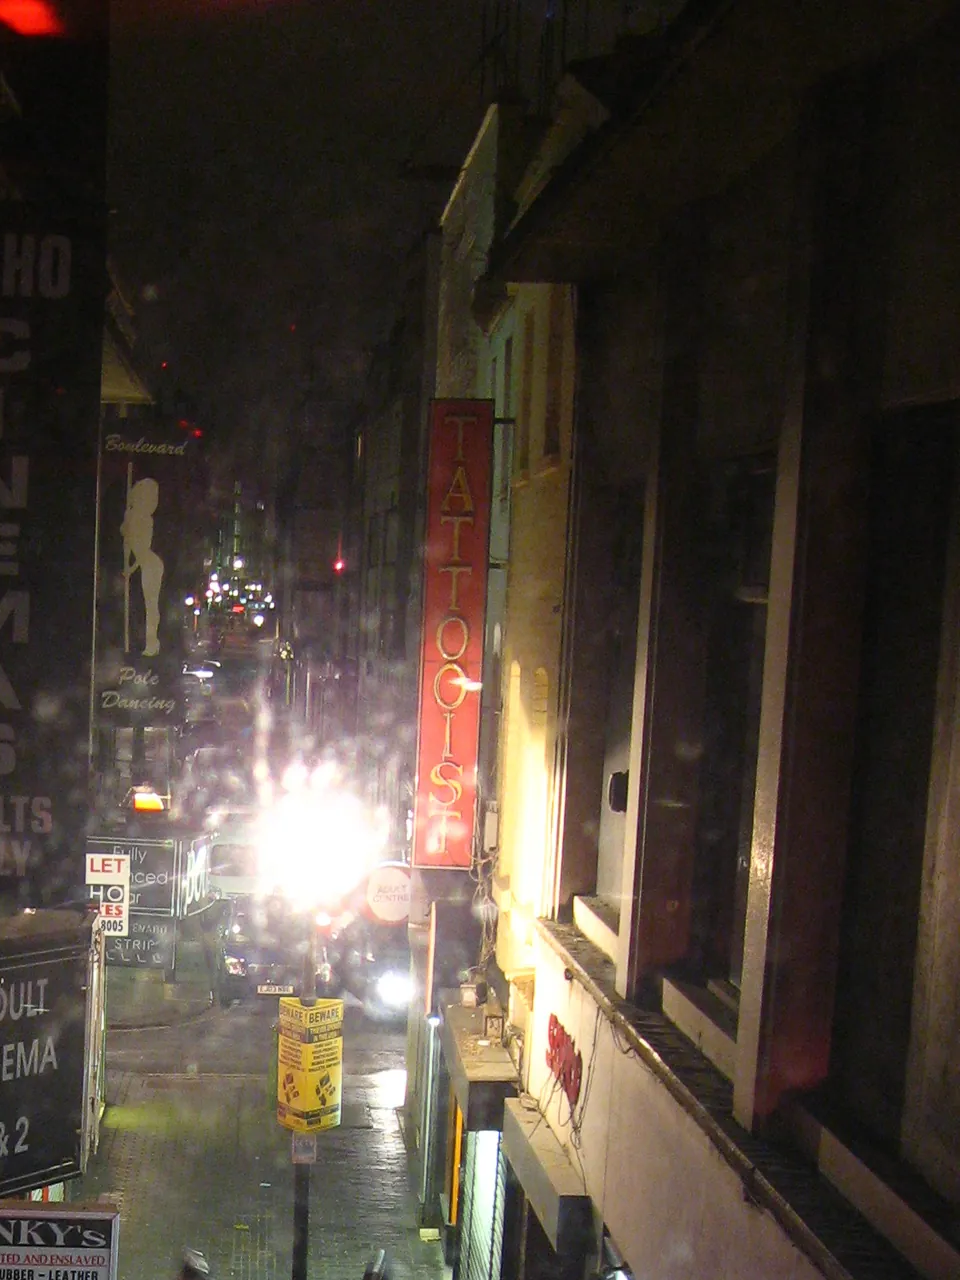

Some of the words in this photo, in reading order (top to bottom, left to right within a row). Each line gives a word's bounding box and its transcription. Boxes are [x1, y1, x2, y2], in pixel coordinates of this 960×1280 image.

[105, 433, 189, 456] Boulevard
[428, 415, 477, 855] TATTOOIST
[118, 666, 159, 685] Pole
[101, 690, 176, 715] Dancing
[90, 857, 126, 874] LET
[24, 1255, 47, 1265] AND
[50, 1255, 106, 1267] ENSLAVED
